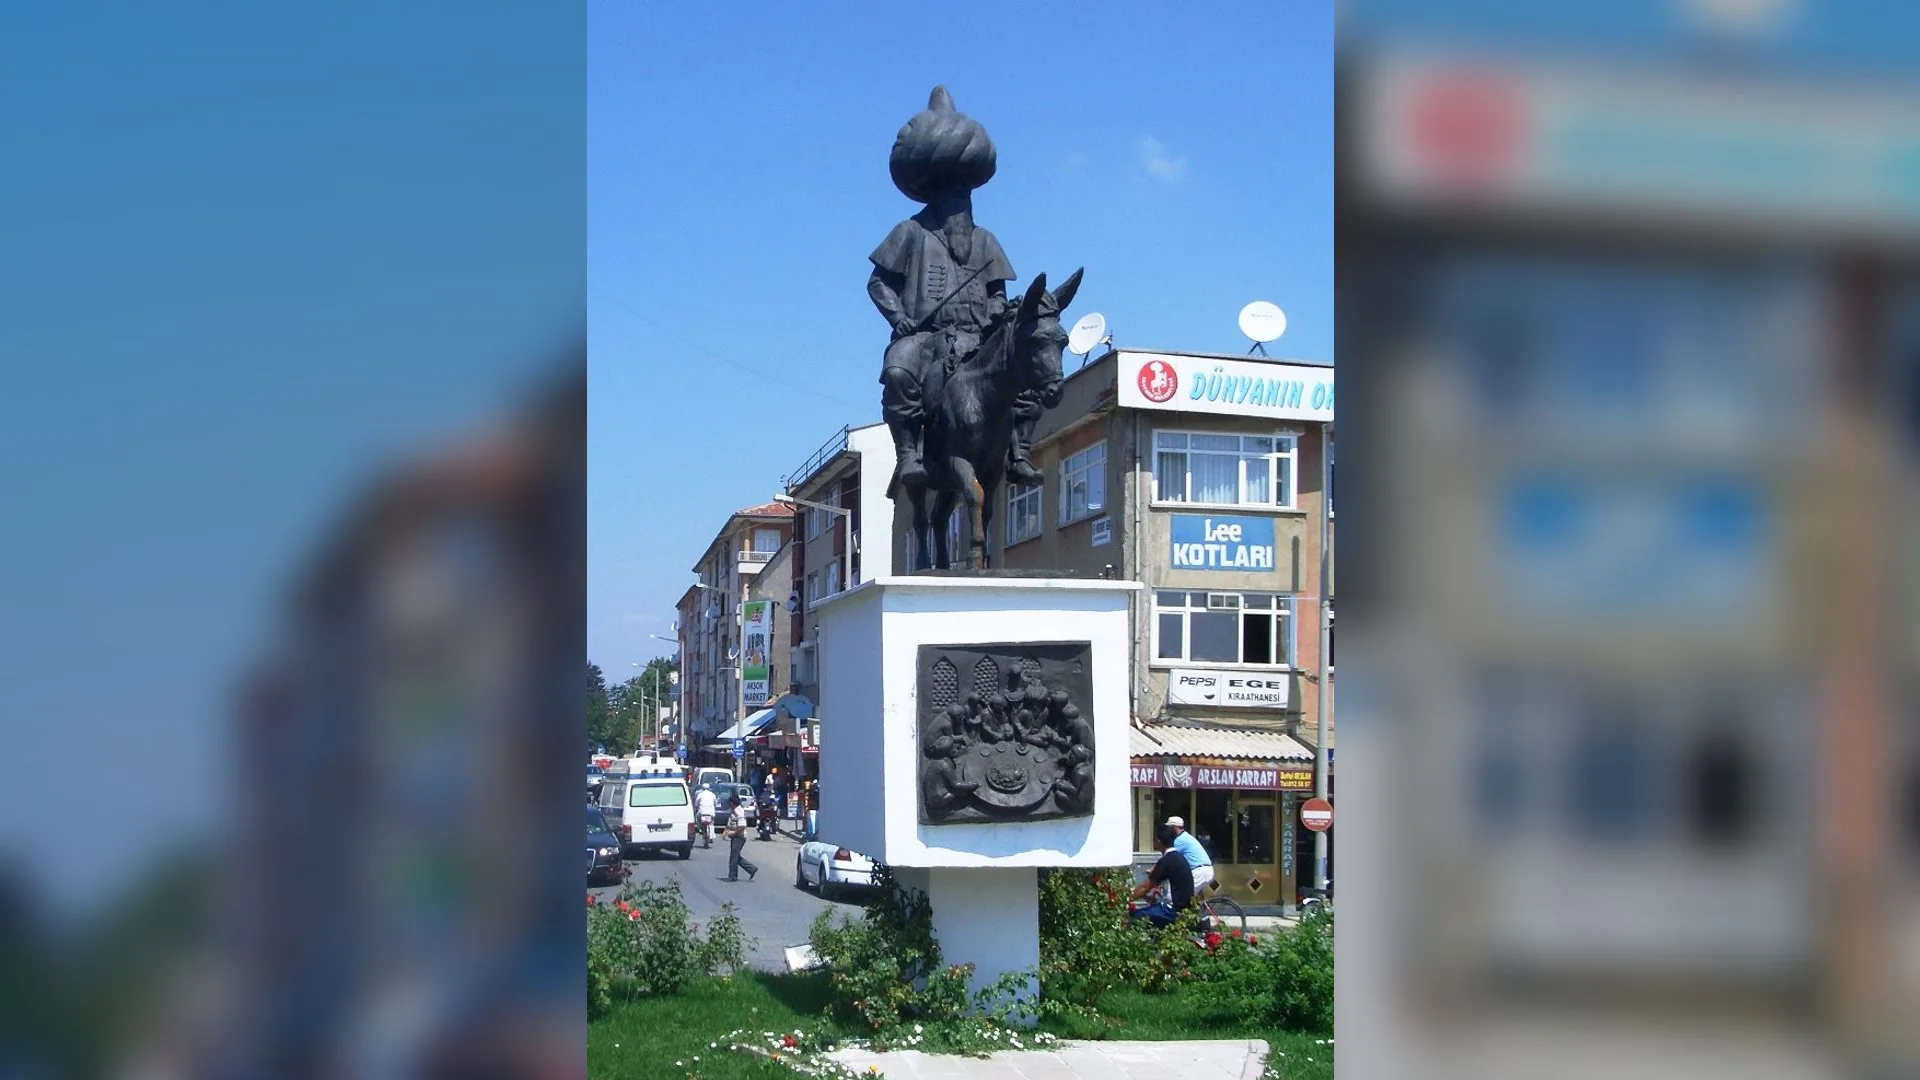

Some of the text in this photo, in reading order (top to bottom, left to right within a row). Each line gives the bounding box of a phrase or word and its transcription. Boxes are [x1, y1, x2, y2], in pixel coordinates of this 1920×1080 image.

[1189, 367, 1304, 409] DÜNYANIN
[1205, 518, 1242, 543] Lee
[1173, 543, 1273, 568] KOTLARI
[1179, 676, 1216, 687] PEPSI
[1228, 679, 1280, 690] EGE
[744, 692, 767, 702] MARKET
[1228, 692, 1280, 702] KIRAATHANESİ
[735, 740, 744, 749] P
[1197, 768, 1235, 786] ARSLAN
[1235, 769, 1277, 787] SARRAFI
